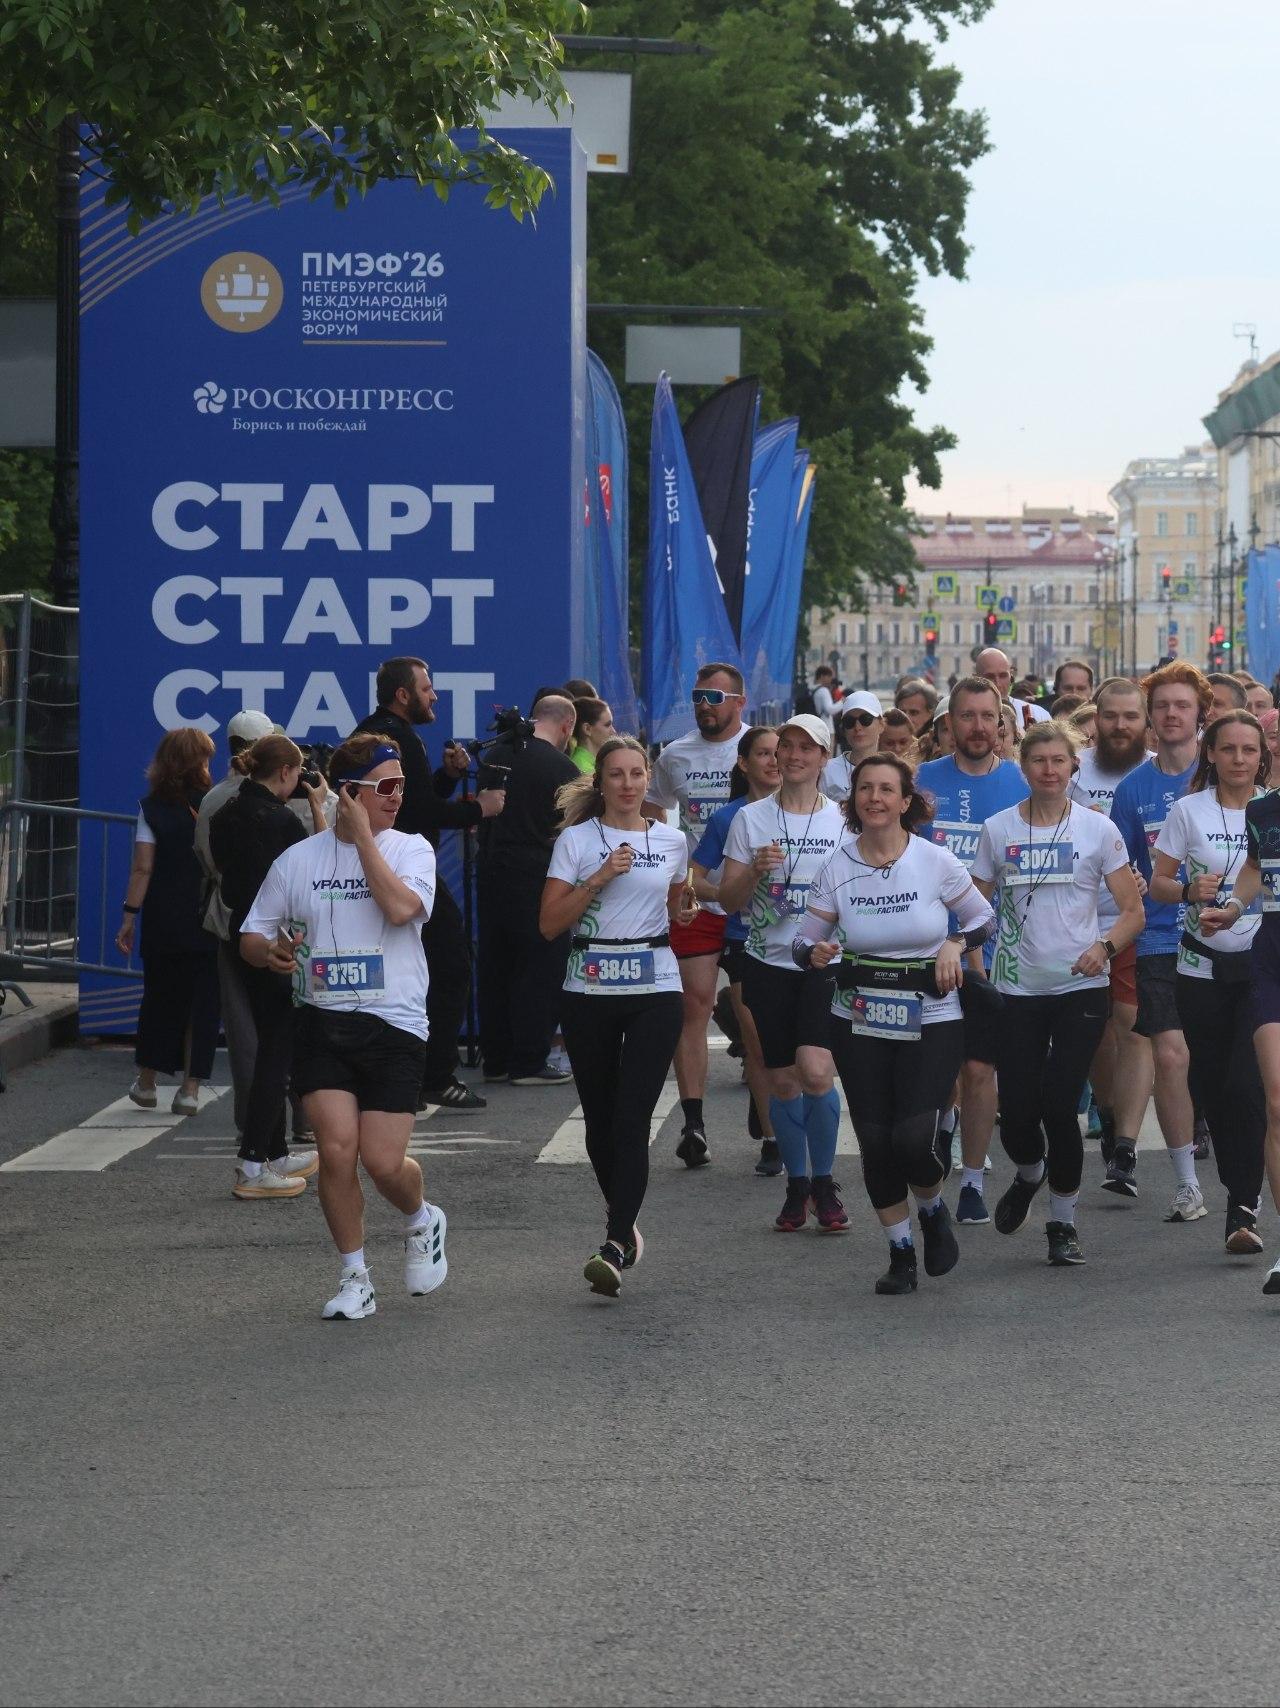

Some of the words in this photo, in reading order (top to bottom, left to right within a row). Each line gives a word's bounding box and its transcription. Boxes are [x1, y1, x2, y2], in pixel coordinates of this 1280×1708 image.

[302, 279, 427, 294] ПЕТЕРБУРГСКИЙ
[302, 294, 447, 308] МЕЖДУНАРОДНЫЙ
[302, 308, 444, 323] ЭКОНОМИЧЕСКИЙ
[302, 323, 359, 337] ФОРУМ
[232, 387, 454, 411] РОСКОНГРЕСС
[232, 417, 283, 434] Борись
[287, 421, 296, 431] и
[298, 417, 367, 433] побеждай
[151, 480, 495, 552] СТАРТ
[151, 574, 495, 646] СТАРТ
[152, 668, 495, 740] СТАТ
[685, 771, 732, 781] УРАЛХ
[312, 878, 371, 891] УРАЛХ
[850, 891, 918, 907] УРАЛХИМ
[327, 962, 367, 986] 3751
[598, 958, 642, 981] 3845
[865, 1001, 909, 1026] 3839
